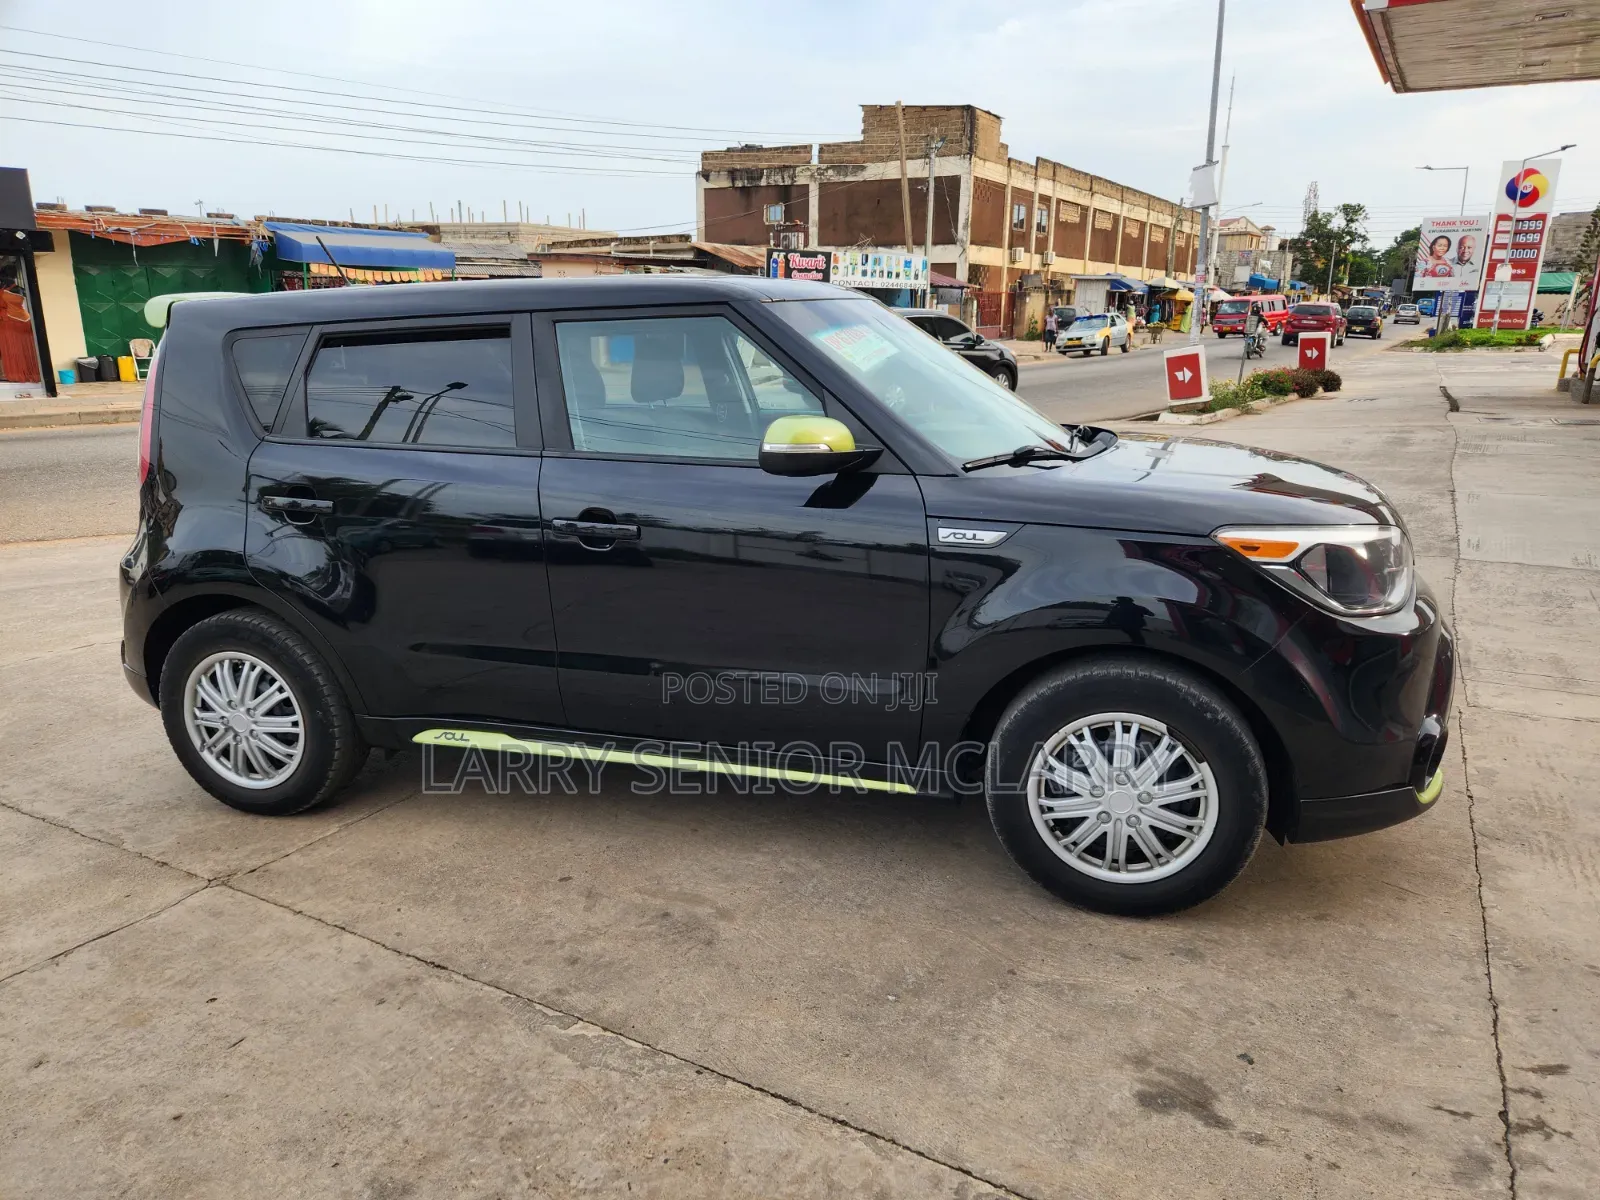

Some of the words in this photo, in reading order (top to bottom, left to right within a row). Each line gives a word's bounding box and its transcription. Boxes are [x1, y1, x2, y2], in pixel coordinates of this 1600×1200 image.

[1518, 220, 1543, 230] 1399
[1516, 232, 1541, 242] 1699
[1509, 249, 1538, 259] 0000
[831, 279, 878, 288] CONTACT:
